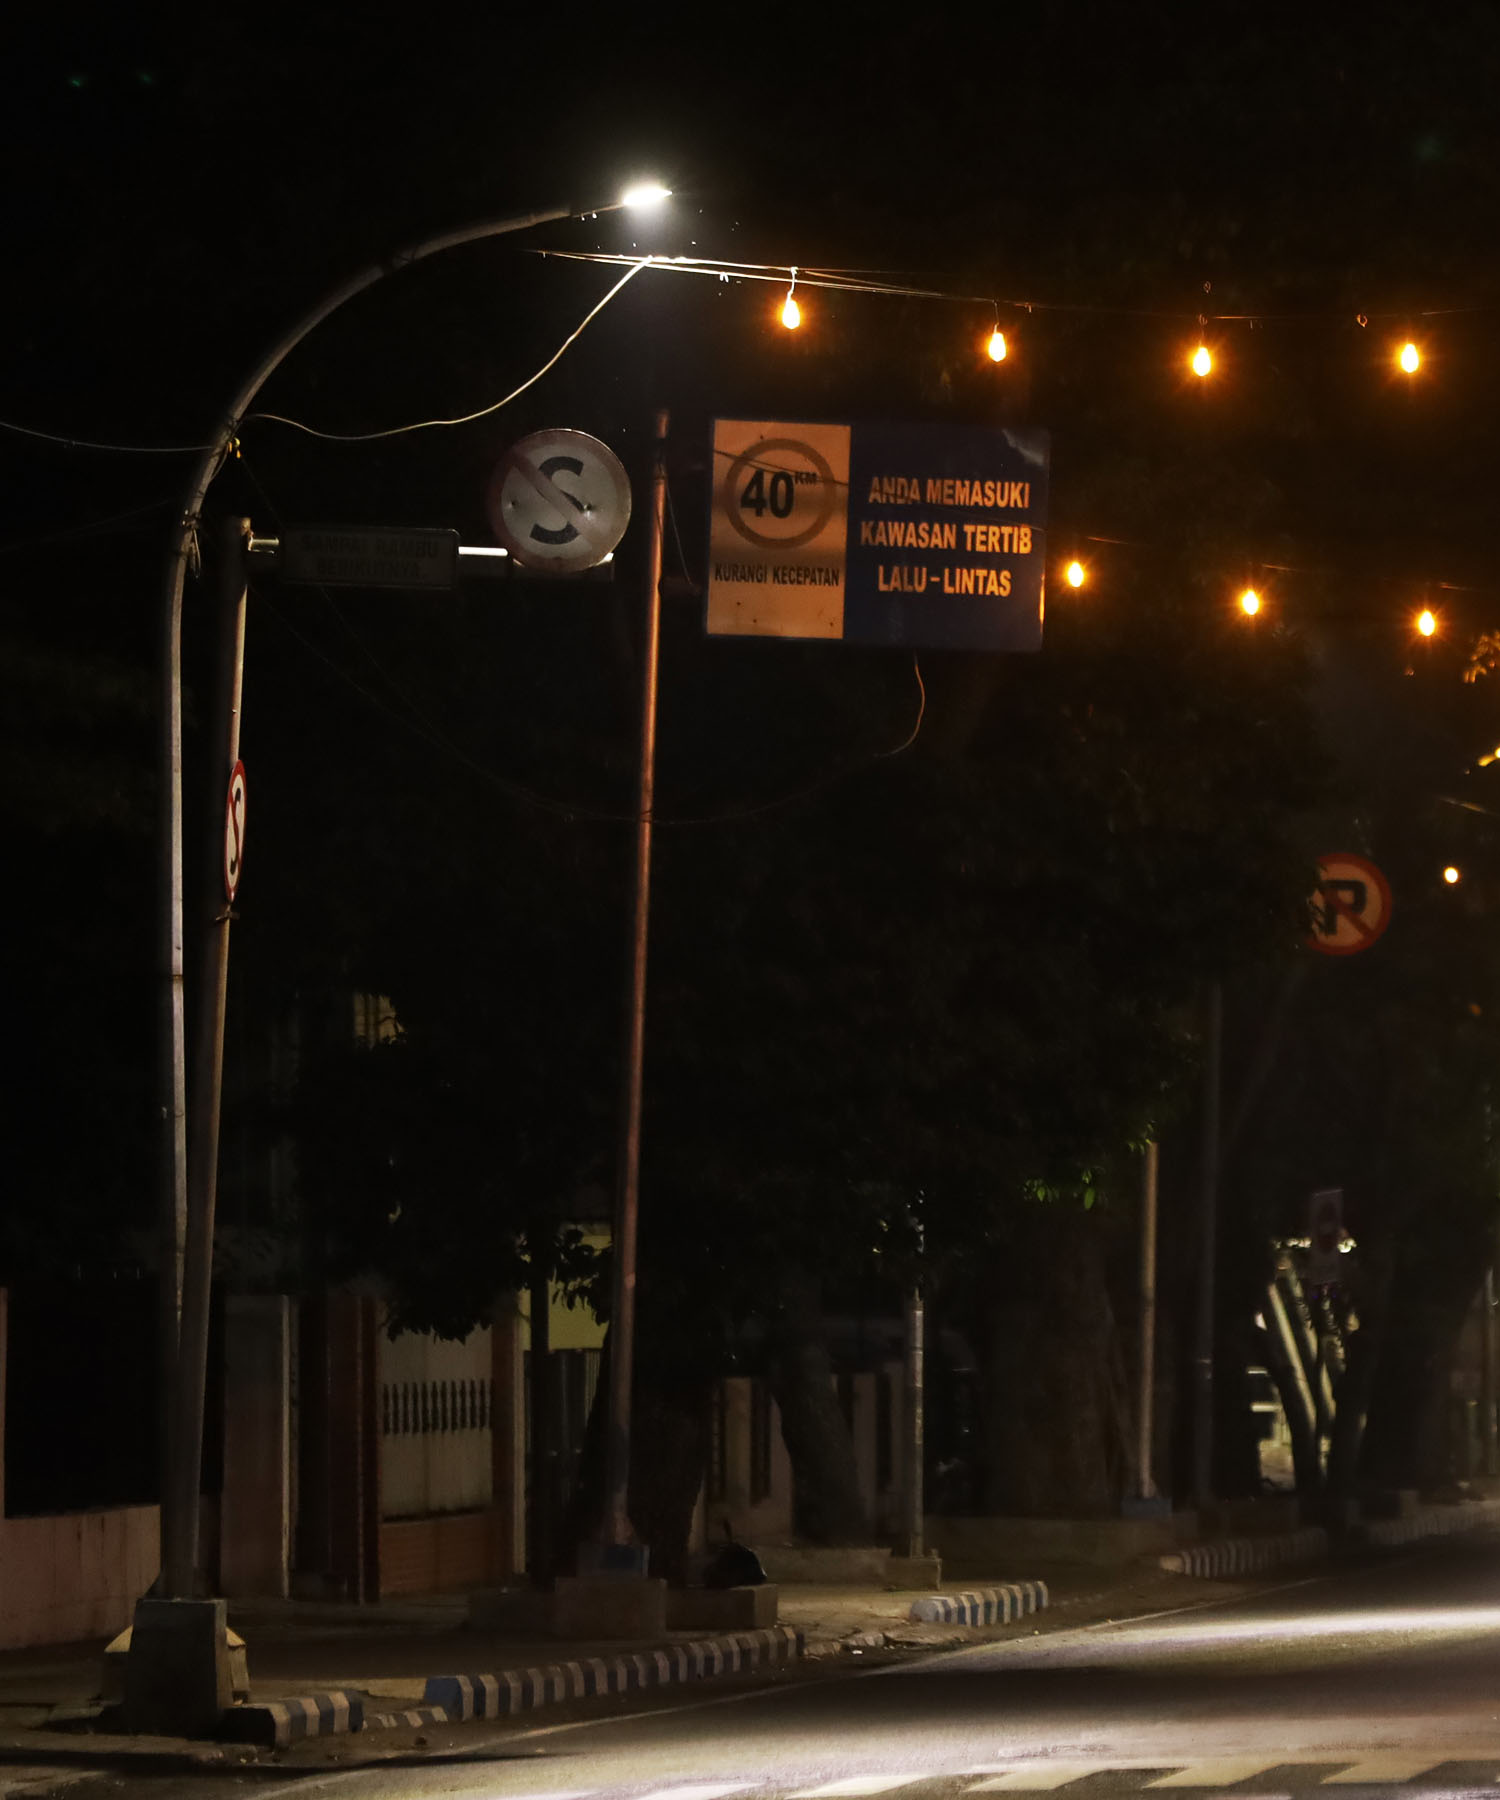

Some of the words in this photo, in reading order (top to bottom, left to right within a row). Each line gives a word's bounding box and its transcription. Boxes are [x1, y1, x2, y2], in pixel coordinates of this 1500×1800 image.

[740, 468, 795, 519] 40
[868, 476, 921, 505] ANDA
[926, 478, 1030, 509] MEMASUKI
[860, 520, 957, 550] KAWASAN
[963, 524, 1033, 555] TERTIB
[714, 564, 768, 585] KURANGI
[771, 566, 841, 588] KECEPATAN
